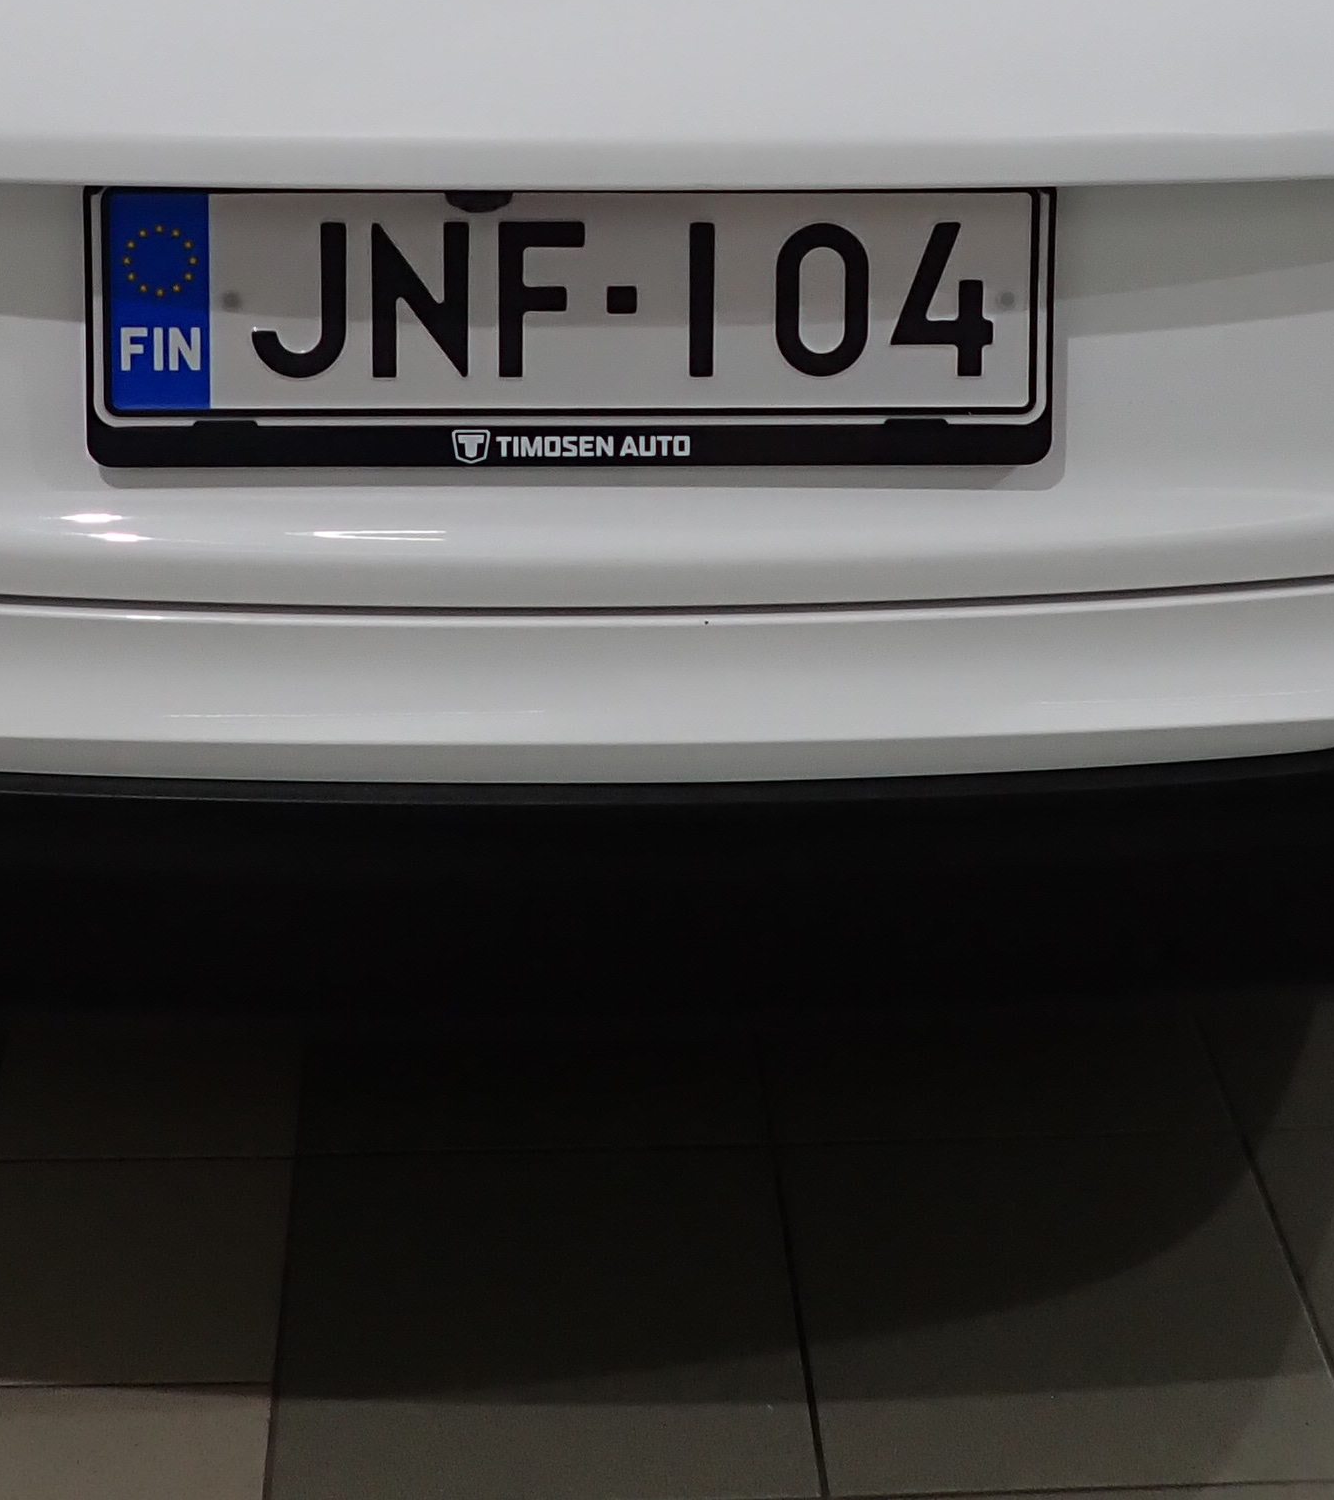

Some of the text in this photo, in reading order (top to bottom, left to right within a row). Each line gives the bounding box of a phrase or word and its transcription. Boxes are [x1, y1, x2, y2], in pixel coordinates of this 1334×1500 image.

[251, 220, 995, 379] JNF-104
[120, 325, 202, 373] FIN
[495, 435, 615, 458] TIMOSEN
[619, 435, 692, 457] AUTO
